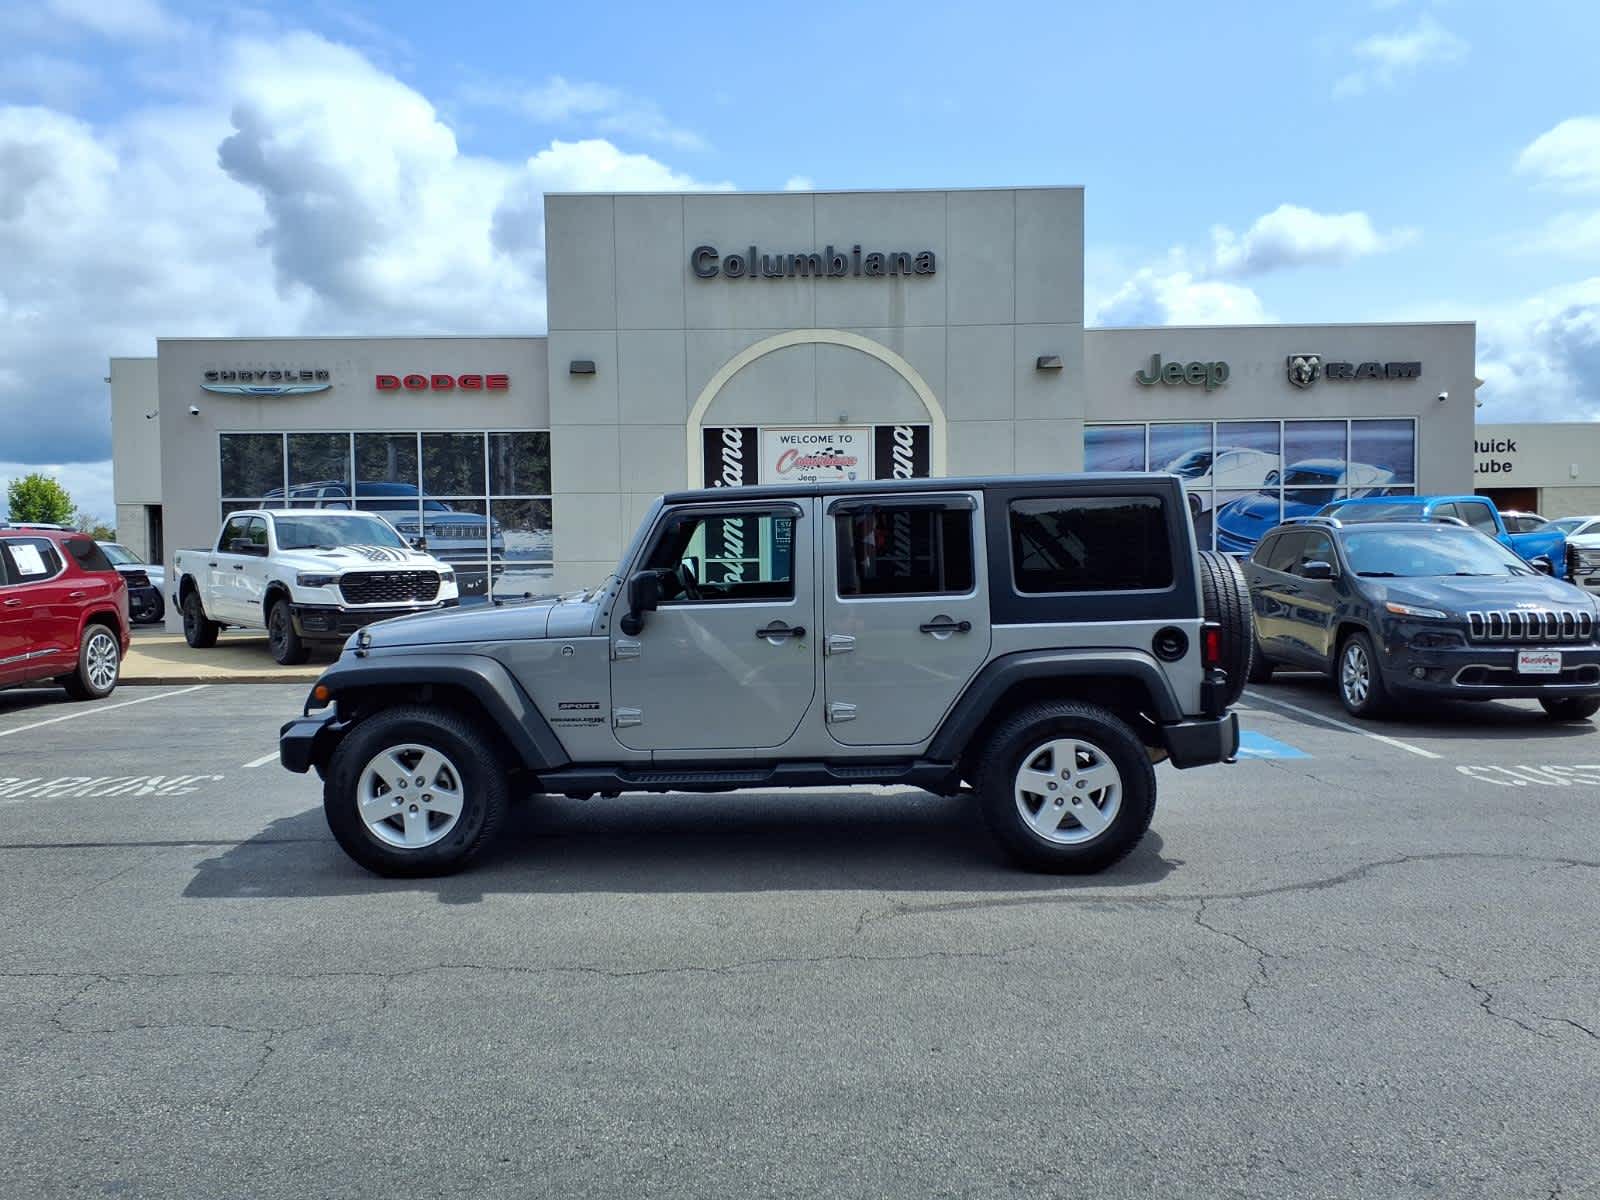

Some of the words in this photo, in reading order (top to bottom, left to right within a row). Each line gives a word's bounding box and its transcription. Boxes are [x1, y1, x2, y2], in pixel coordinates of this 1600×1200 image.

[691, 245, 936, 278] Columbiana
[204, 369, 330, 381] CHRYSLER
[1135, 353, 1230, 392] Jeep
[1325, 361, 1422, 379] RAM
[375, 374, 510, 391] DODGE
[780, 435, 833, 444] WELCOME
[839, 434, 853, 443] TO
[1474, 439, 1517, 453] uick
[1474, 459, 1513, 473] ube
